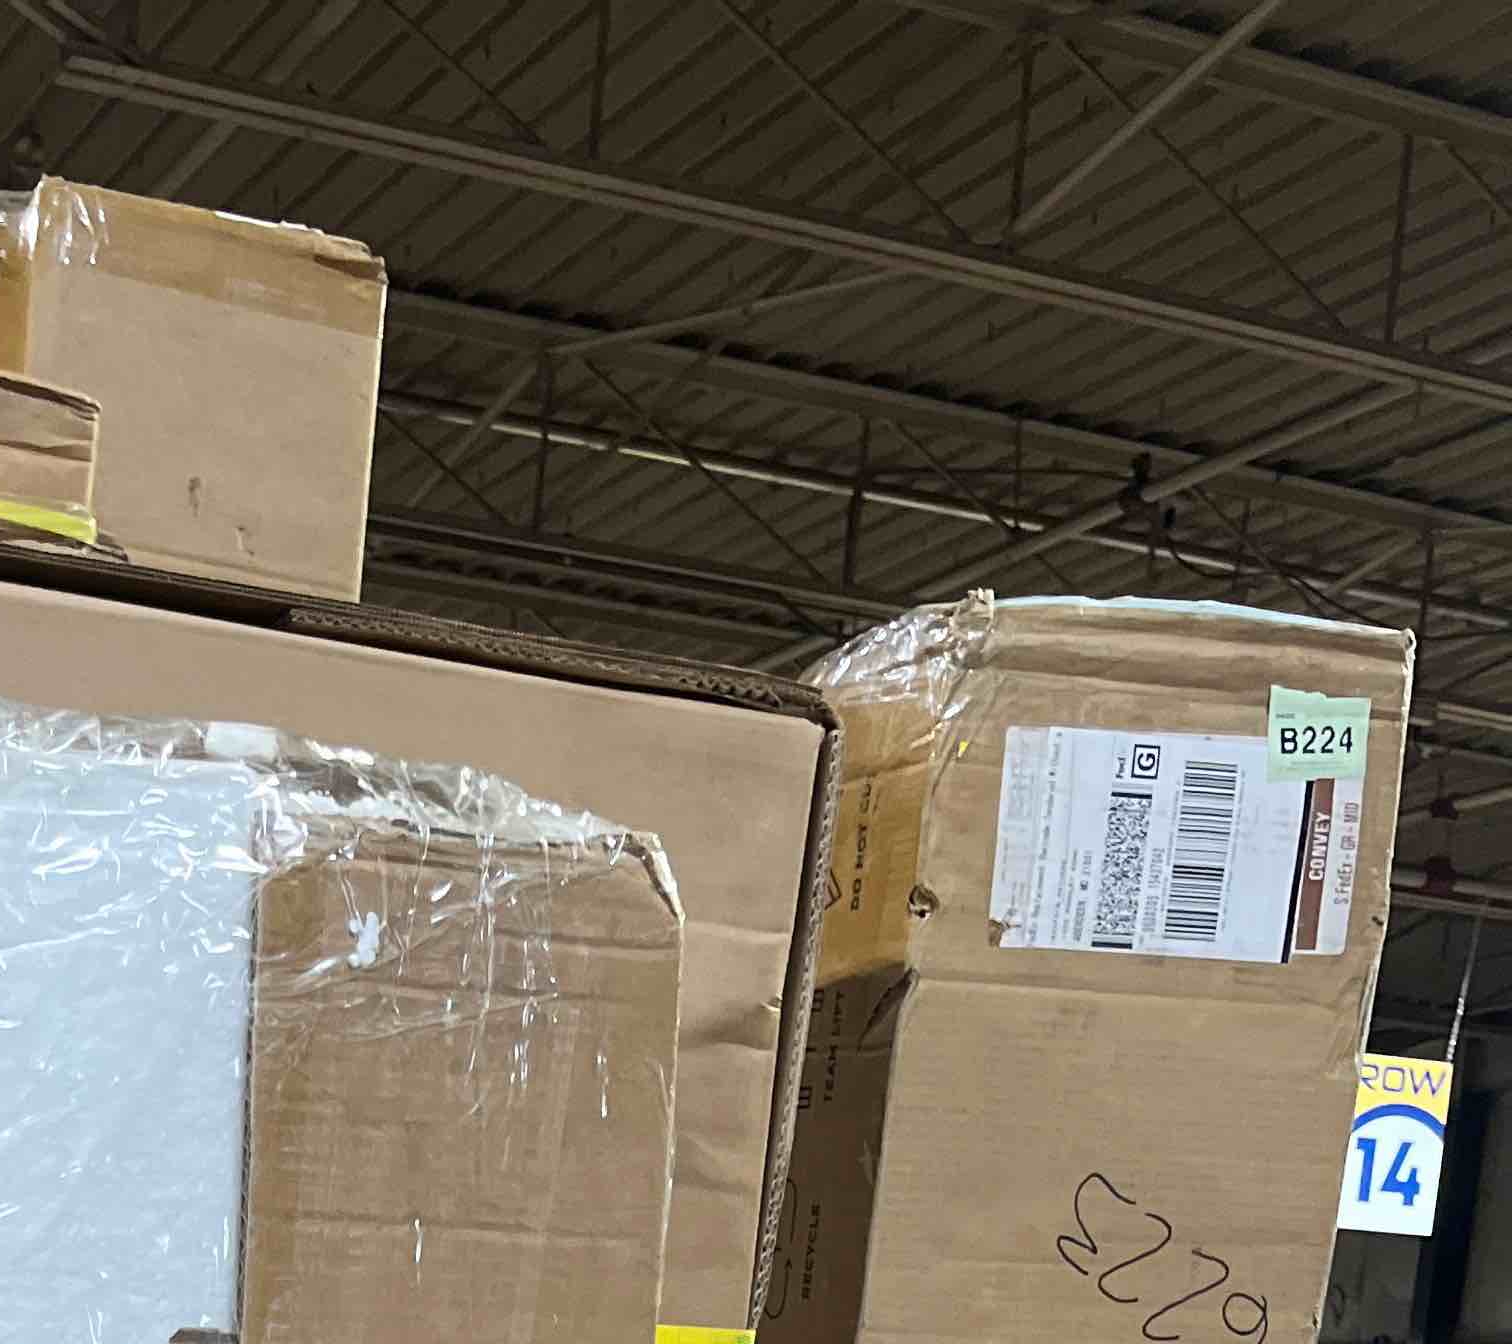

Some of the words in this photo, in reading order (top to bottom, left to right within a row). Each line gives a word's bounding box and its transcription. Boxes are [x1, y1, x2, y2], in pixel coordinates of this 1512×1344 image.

[1280, 726, 1353, 754] B224
[1138, 752, 1155, 772] G
[1309, 811, 1331, 881] CONVEY
[1359, 1063, 1446, 1098] ROW
[1356, 1137, 1422, 1207] 14
